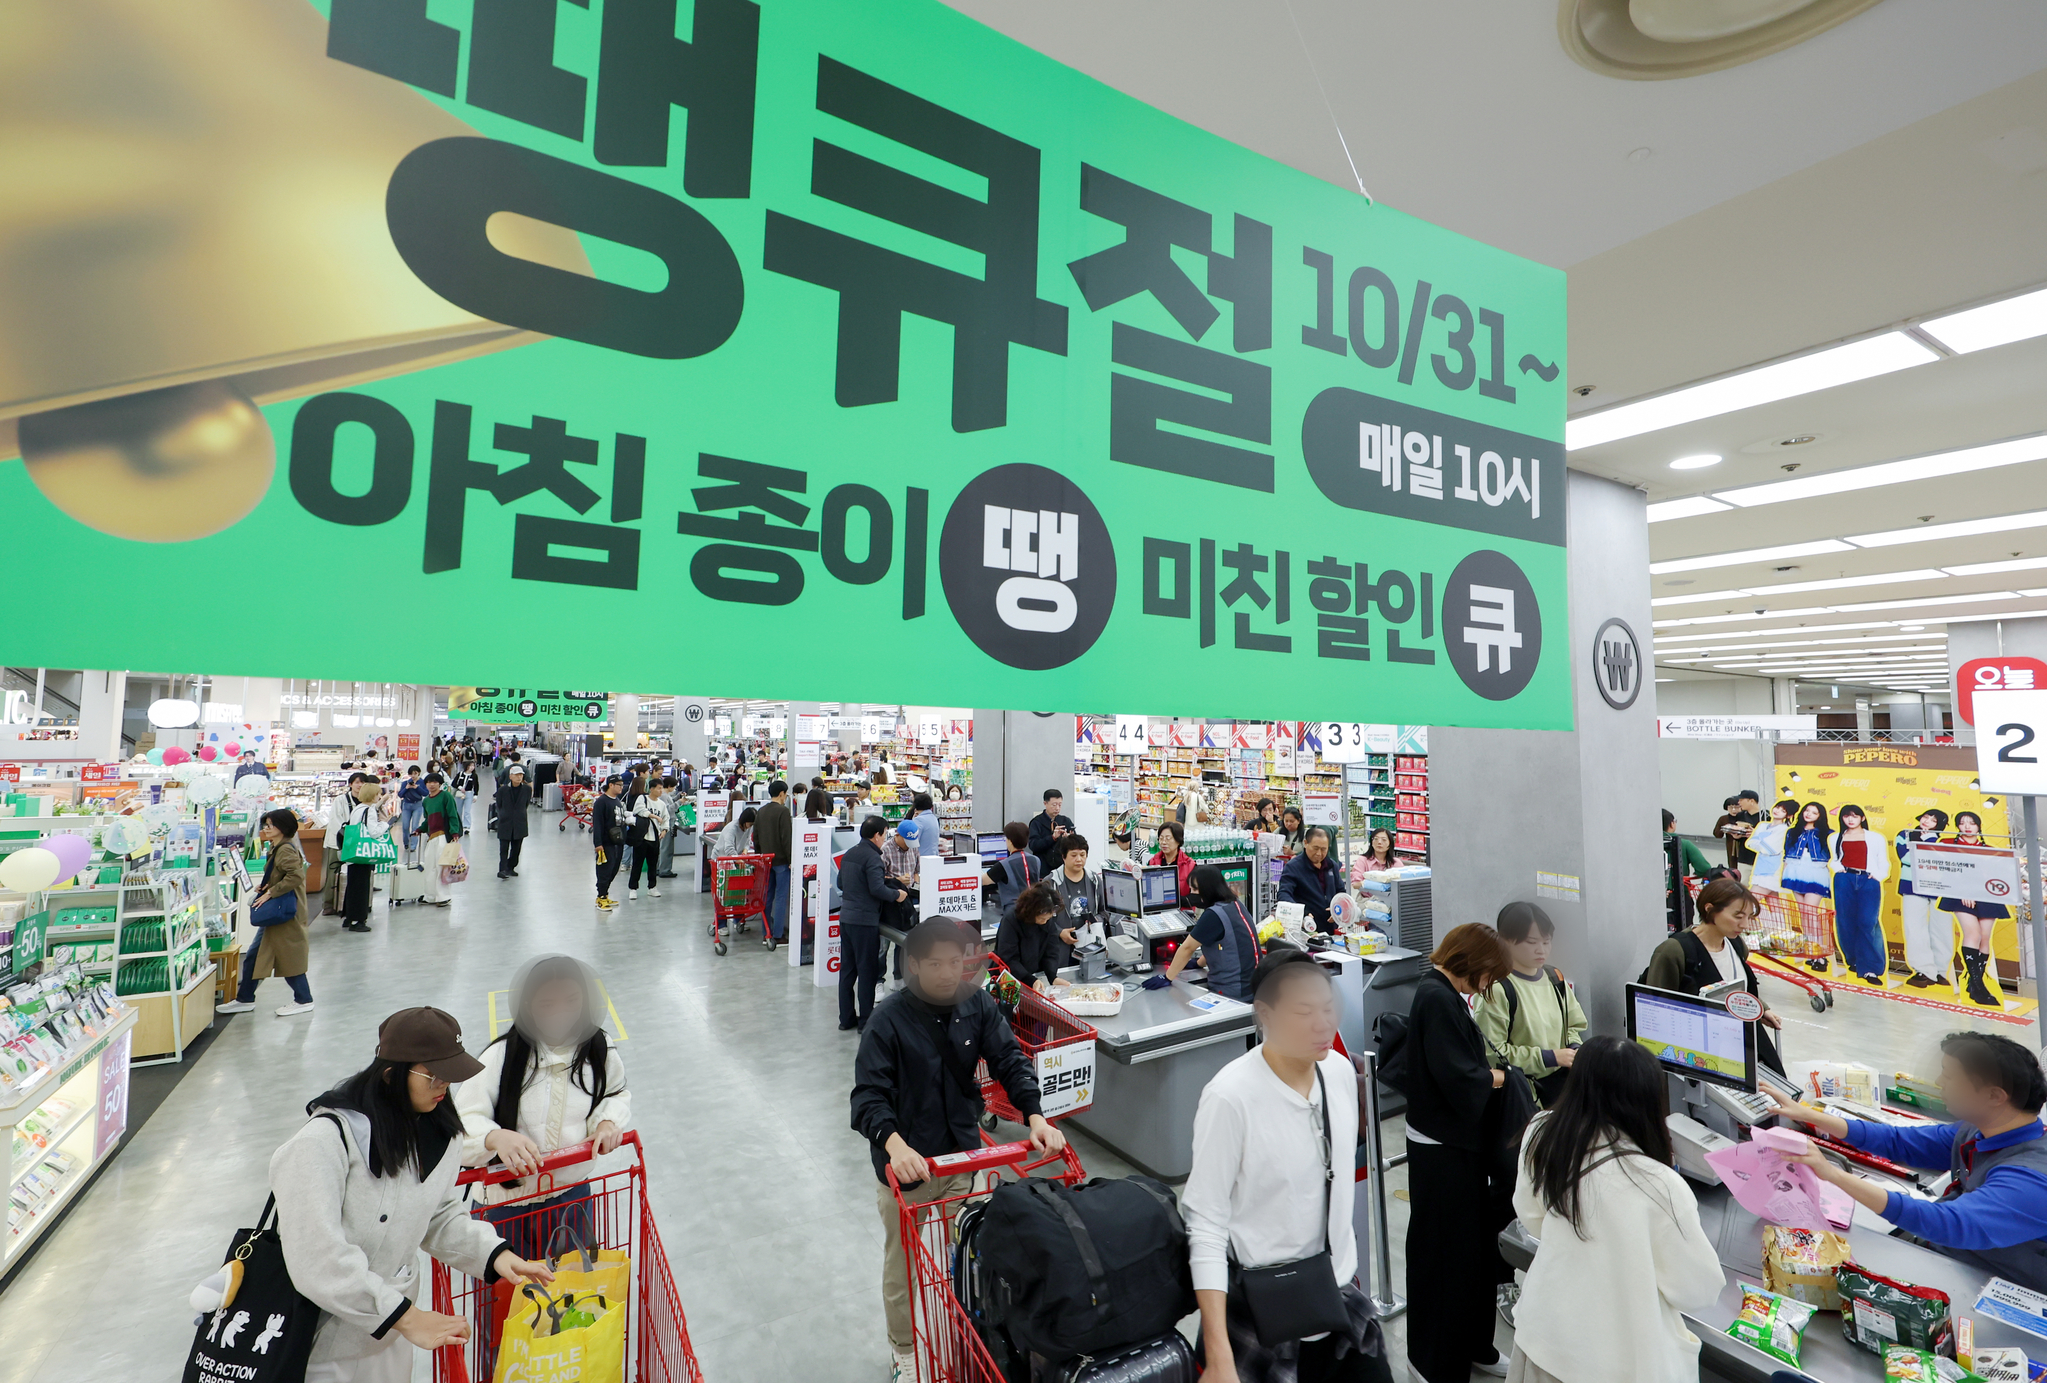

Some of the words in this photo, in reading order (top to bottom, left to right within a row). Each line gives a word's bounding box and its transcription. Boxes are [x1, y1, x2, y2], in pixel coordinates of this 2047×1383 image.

[1302, 245, 1560, 404] 10/31~
[1360, 422, 1443, 500] 매일
[1454, 444, 1540, 519] 10시
[289, 392, 646, 591] 아침
[677, 452, 928, 621] 종이
[983, 503, 1079, 634] 땡
[1143, 536, 1292, 653] 미친
[1307, 556, 1436, 665] 할인
[1463, 583, 1522, 674] 큐
[1974, 666, 2034, 690] 오늘
[470, 702, 492, 714] 아침
[495, 702, 517, 714] 종이
[522, 703, 534, 714] 땡
[540, 704, 560, 715] 미친
[563, 704, 583, 716] 할인
[587, 705, 599, 716] 큐
[870, 724, 876, 734] 6
[931, 724, 938, 736] 5
[1120, 724, 1127, 740] 4
[1134, 724, 1144, 740] 4
[1328, 723, 1342, 746] 3
[1352, 723, 1360, 746] 3
[1996, 723, 2038, 764] 2
[1843, 752, 1918, 766] PEPERO
[1840, 778, 1870, 788] PEPERO
[1935, 775, 1970, 785] PEPERO
[1904, 796, 1938, 807] PEPERO
[939, 895, 968, 905] 롯데마트
[1044, 1055, 1062, 1069] 역시
[195, 1351, 216, 1372] OVER
[215, 1362, 258, 1380] ACTION
